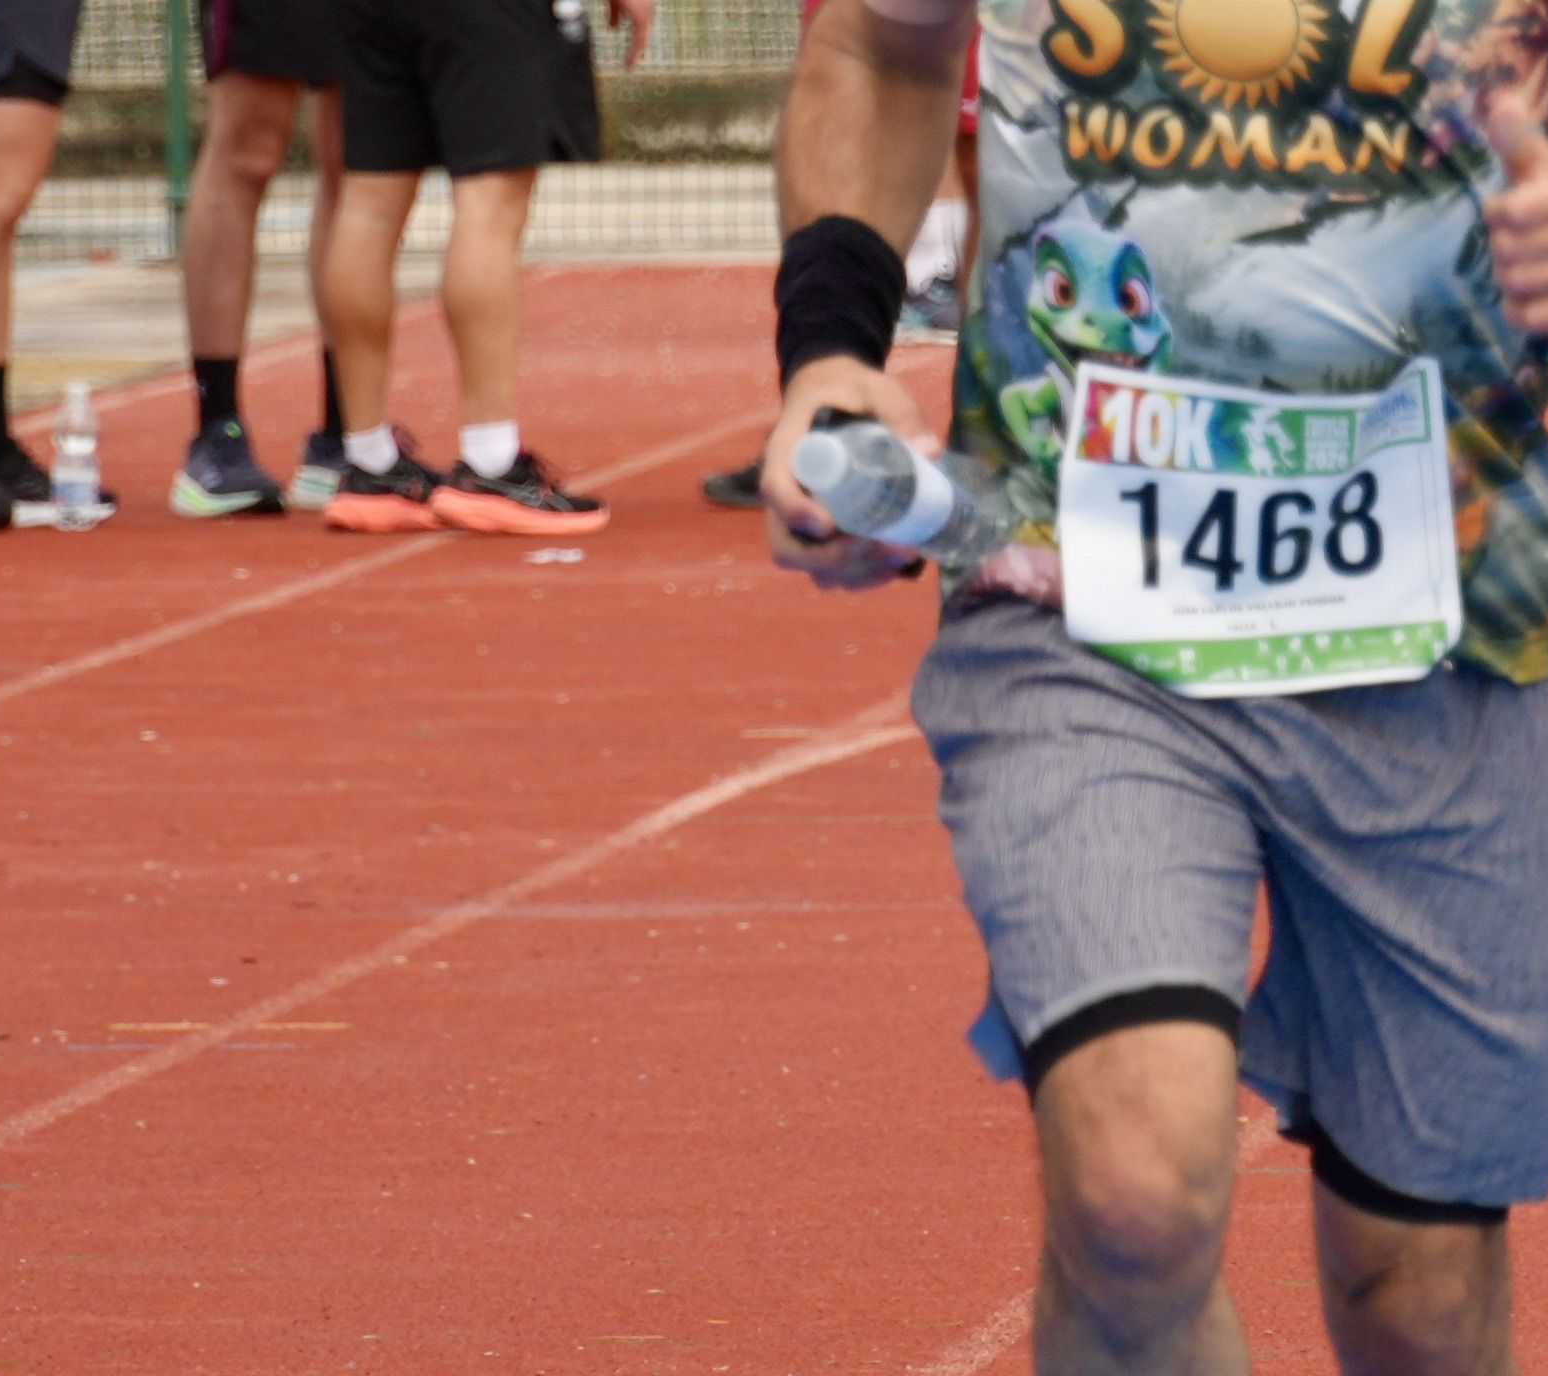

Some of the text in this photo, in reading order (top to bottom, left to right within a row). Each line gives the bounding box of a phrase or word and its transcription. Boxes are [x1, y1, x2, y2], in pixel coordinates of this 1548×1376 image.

[1065, 101, 1410, 176] WOMAN
[1102, 388, 1216, 471] 10K
[1119, 470, 1385, 592] 1468
